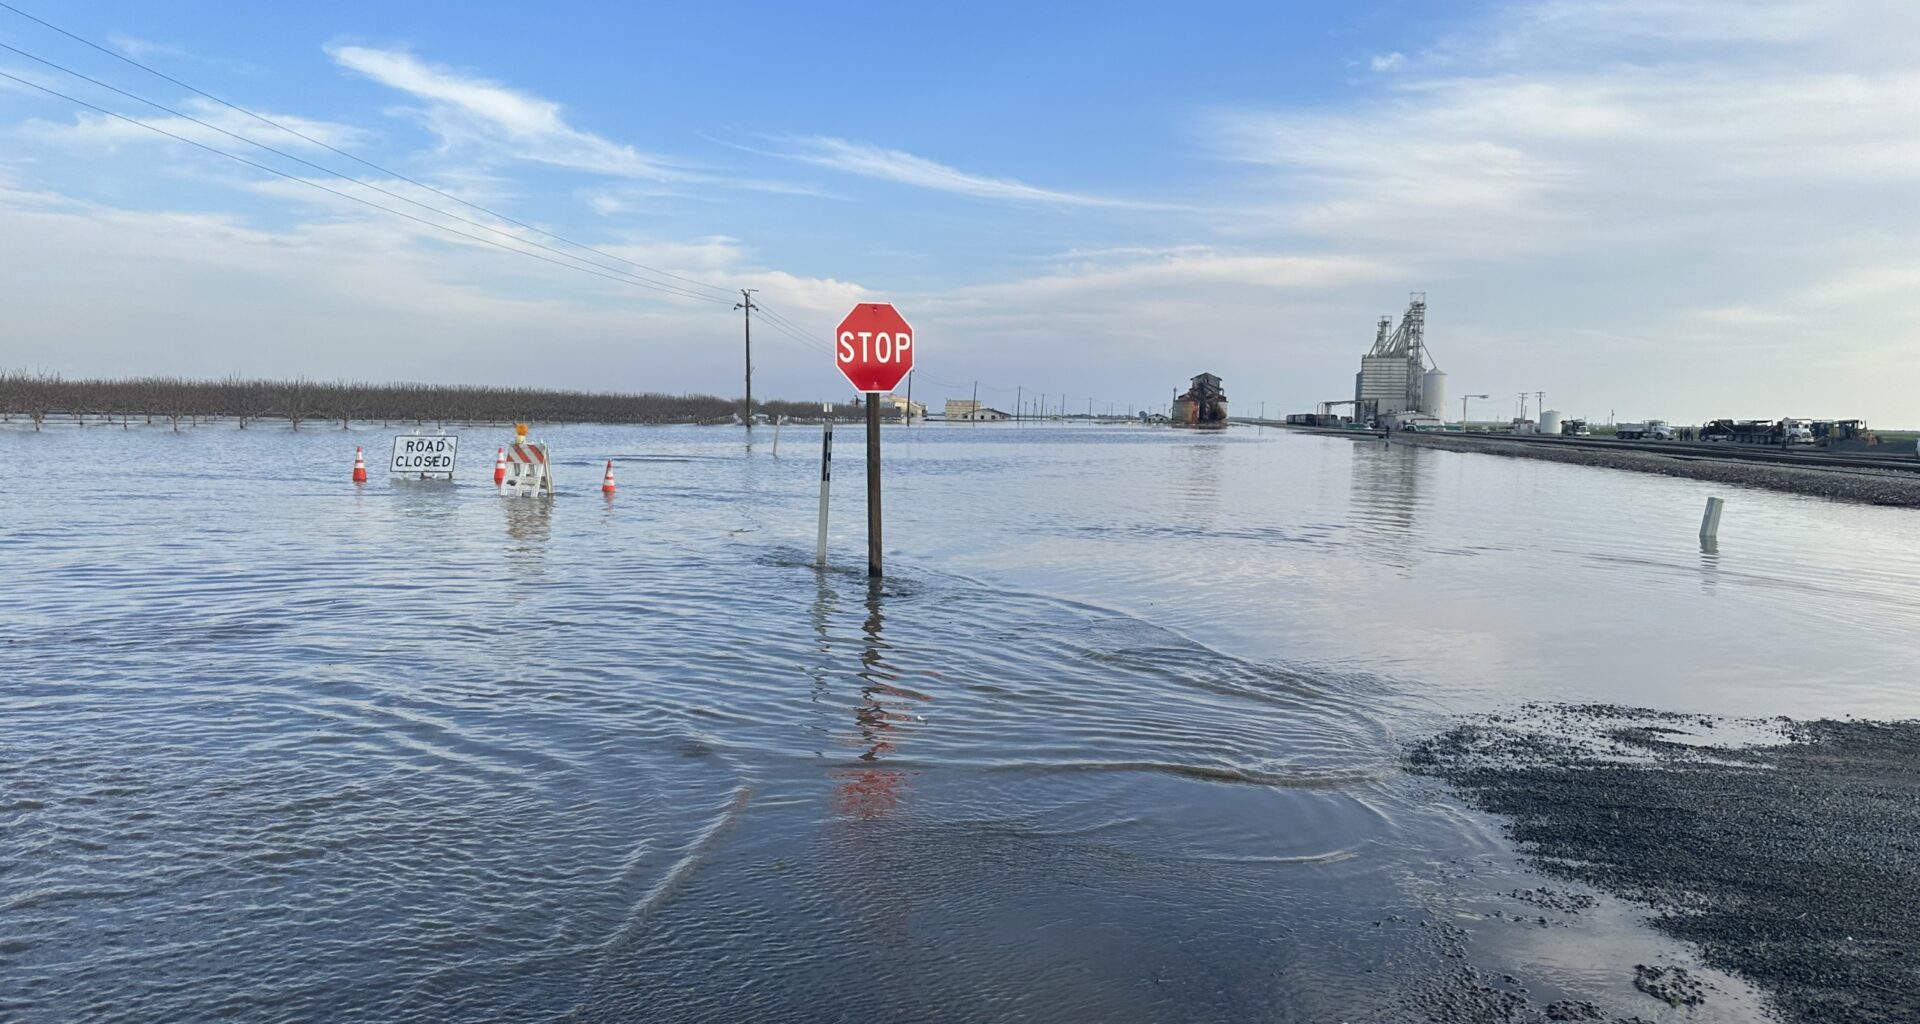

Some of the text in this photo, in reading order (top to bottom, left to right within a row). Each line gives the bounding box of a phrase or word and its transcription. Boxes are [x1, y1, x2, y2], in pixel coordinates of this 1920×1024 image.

[839, 331, 911, 364] STOP
[406, 441, 445, 452] ROAD
[395, 456, 451, 467] CLOSED
